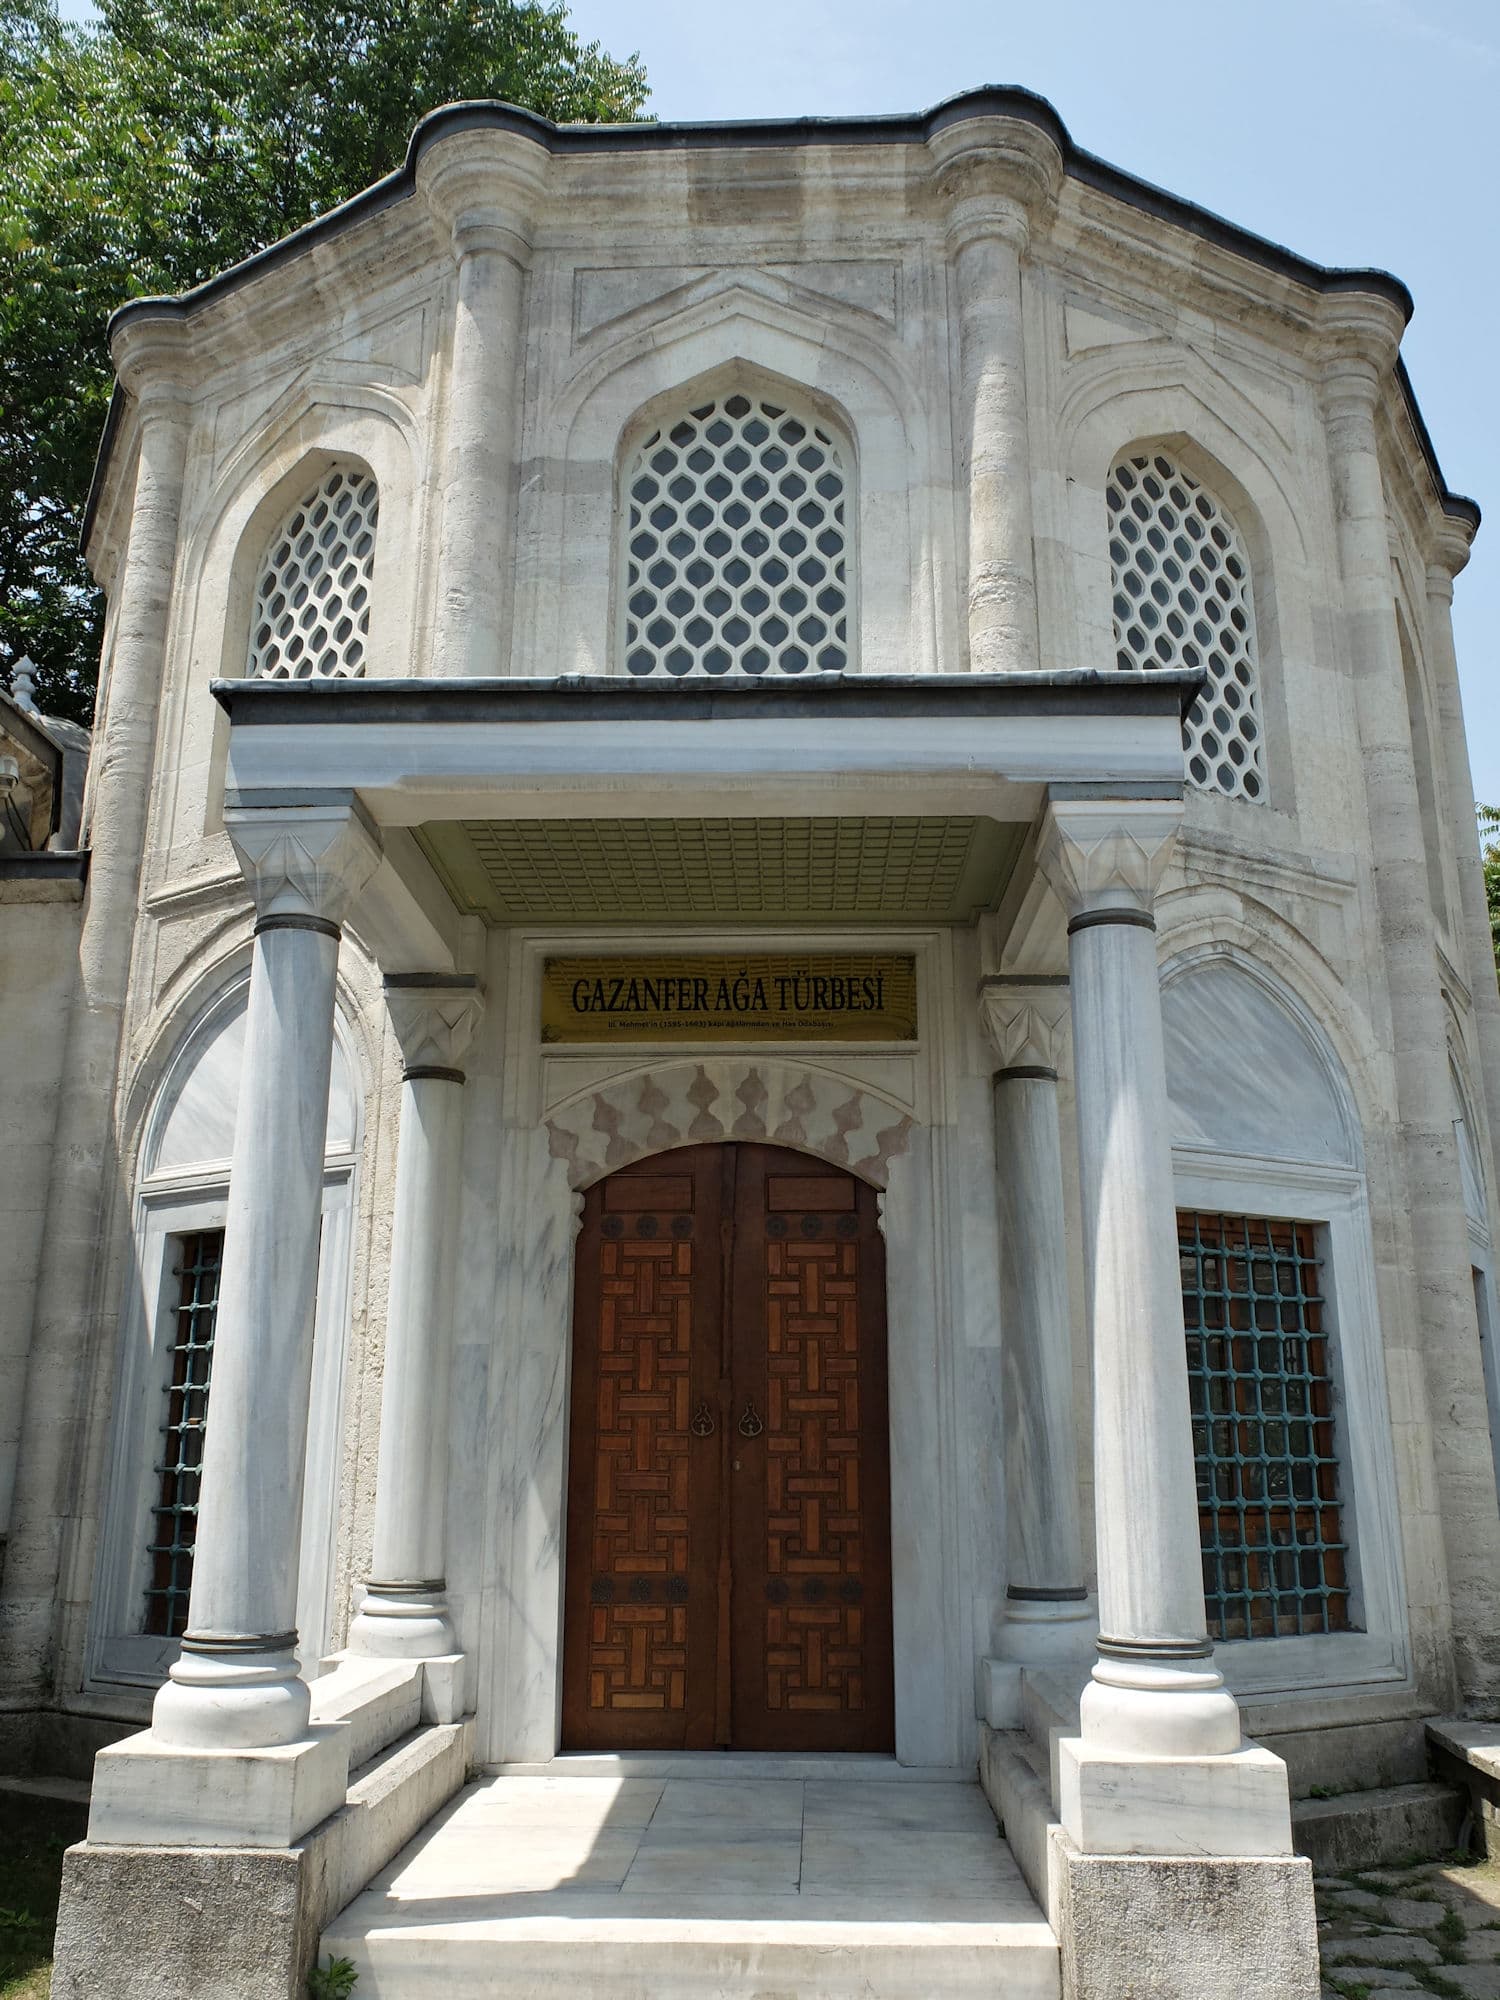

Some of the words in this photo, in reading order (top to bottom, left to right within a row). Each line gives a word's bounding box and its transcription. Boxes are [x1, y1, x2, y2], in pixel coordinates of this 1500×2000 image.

[572, 978, 709, 1012] GAZANFER
[715, 969, 768, 1012] AĞA
[775, 970, 884, 1011] TÜRBESİ
